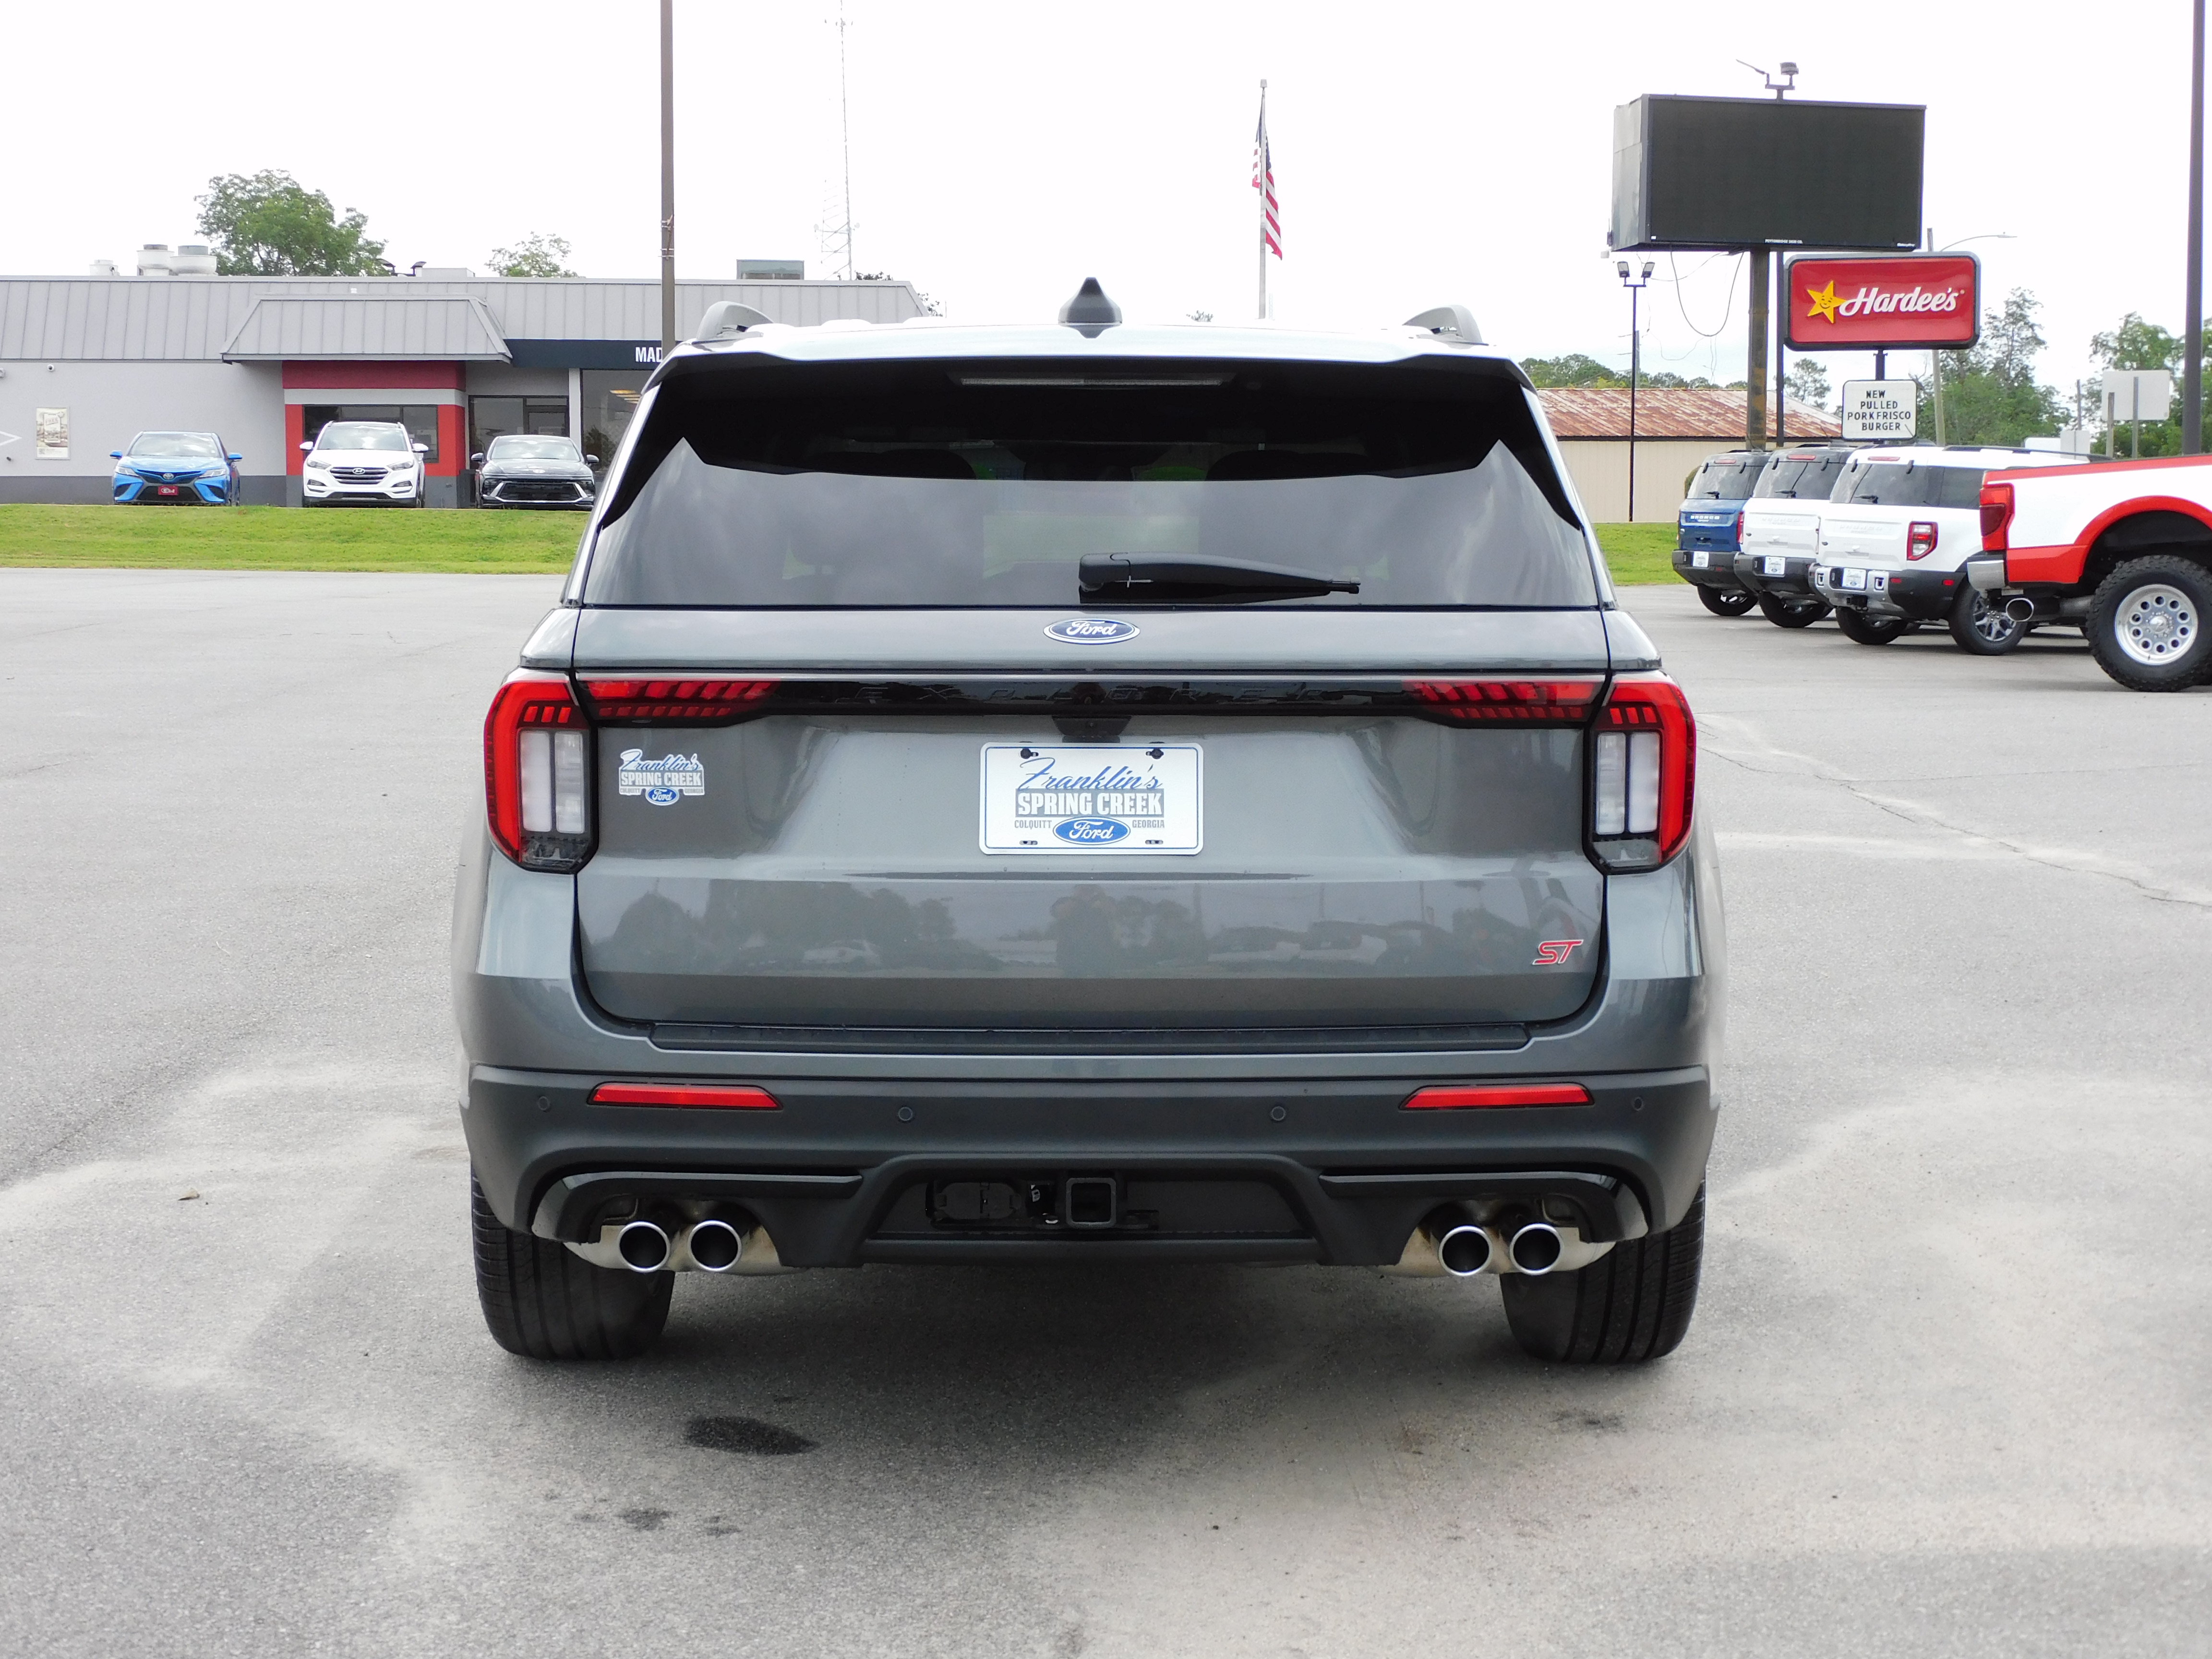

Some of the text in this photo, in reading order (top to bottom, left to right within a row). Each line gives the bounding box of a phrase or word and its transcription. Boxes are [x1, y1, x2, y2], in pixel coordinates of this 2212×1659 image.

[1839, 287, 1959, 316] Hardee's
[1866, 390, 1886, 399] NEW
[1860, 400, 1898, 409] PULLED
[1847, 411, 1911, 421] PORK FRISCO
[1862, 422, 1901, 431] BURGER
[1066, 620, 1118, 635] Ford
[621, 750, 702, 771] Franklin's
[621, 771, 701, 786] SPRING CREEK
[1017, 757, 1164, 791] Franklin's
[651, 788, 672, 801] Ford
[1017, 792, 1163, 815] SPRING CREEK
[1014, 819, 1165, 840] COLQUITT Ford GEORGIA
[1532, 939, 1584, 965] ST
